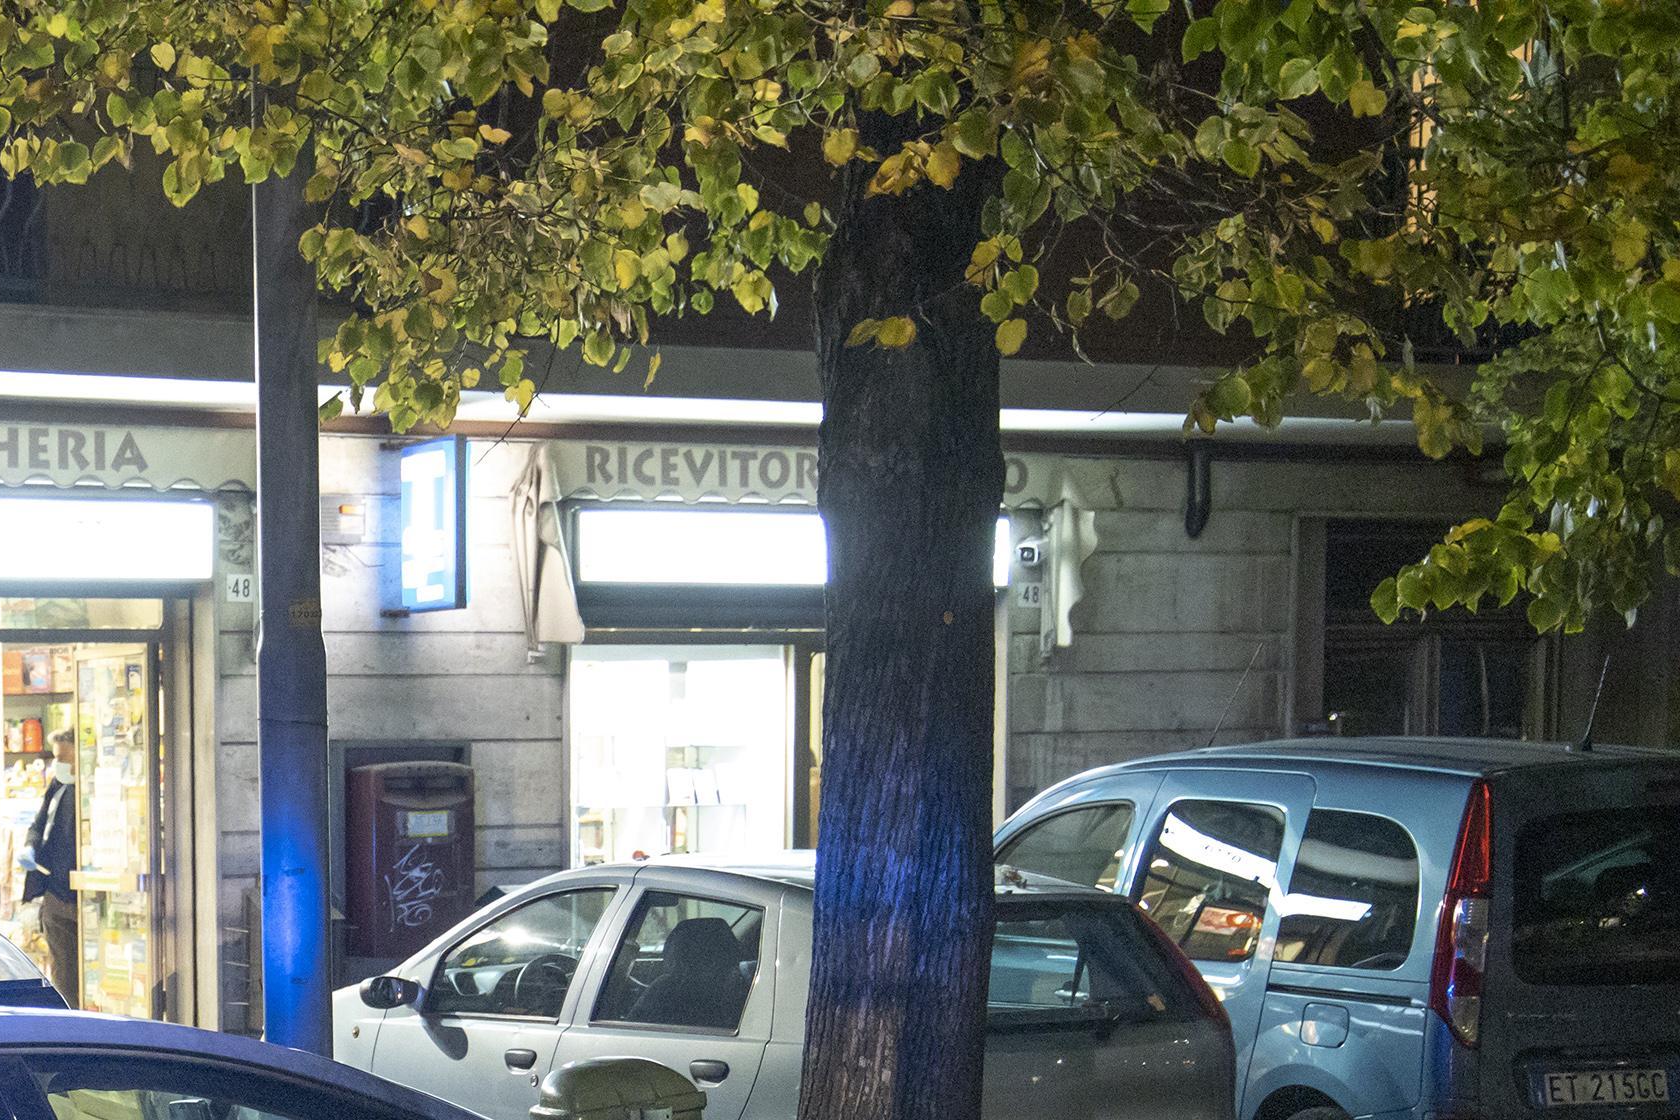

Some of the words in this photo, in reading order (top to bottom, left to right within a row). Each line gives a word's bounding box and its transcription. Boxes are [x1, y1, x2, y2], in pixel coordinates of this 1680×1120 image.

[585, 445, 819, 490] RICEVITOR
[231, 578, 251, 598] 48
[1022, 585, 1040, 604] 48
[1549, 1075, 1578, 1102] ET
[1590, 1072, 1665, 1101] 215GC
